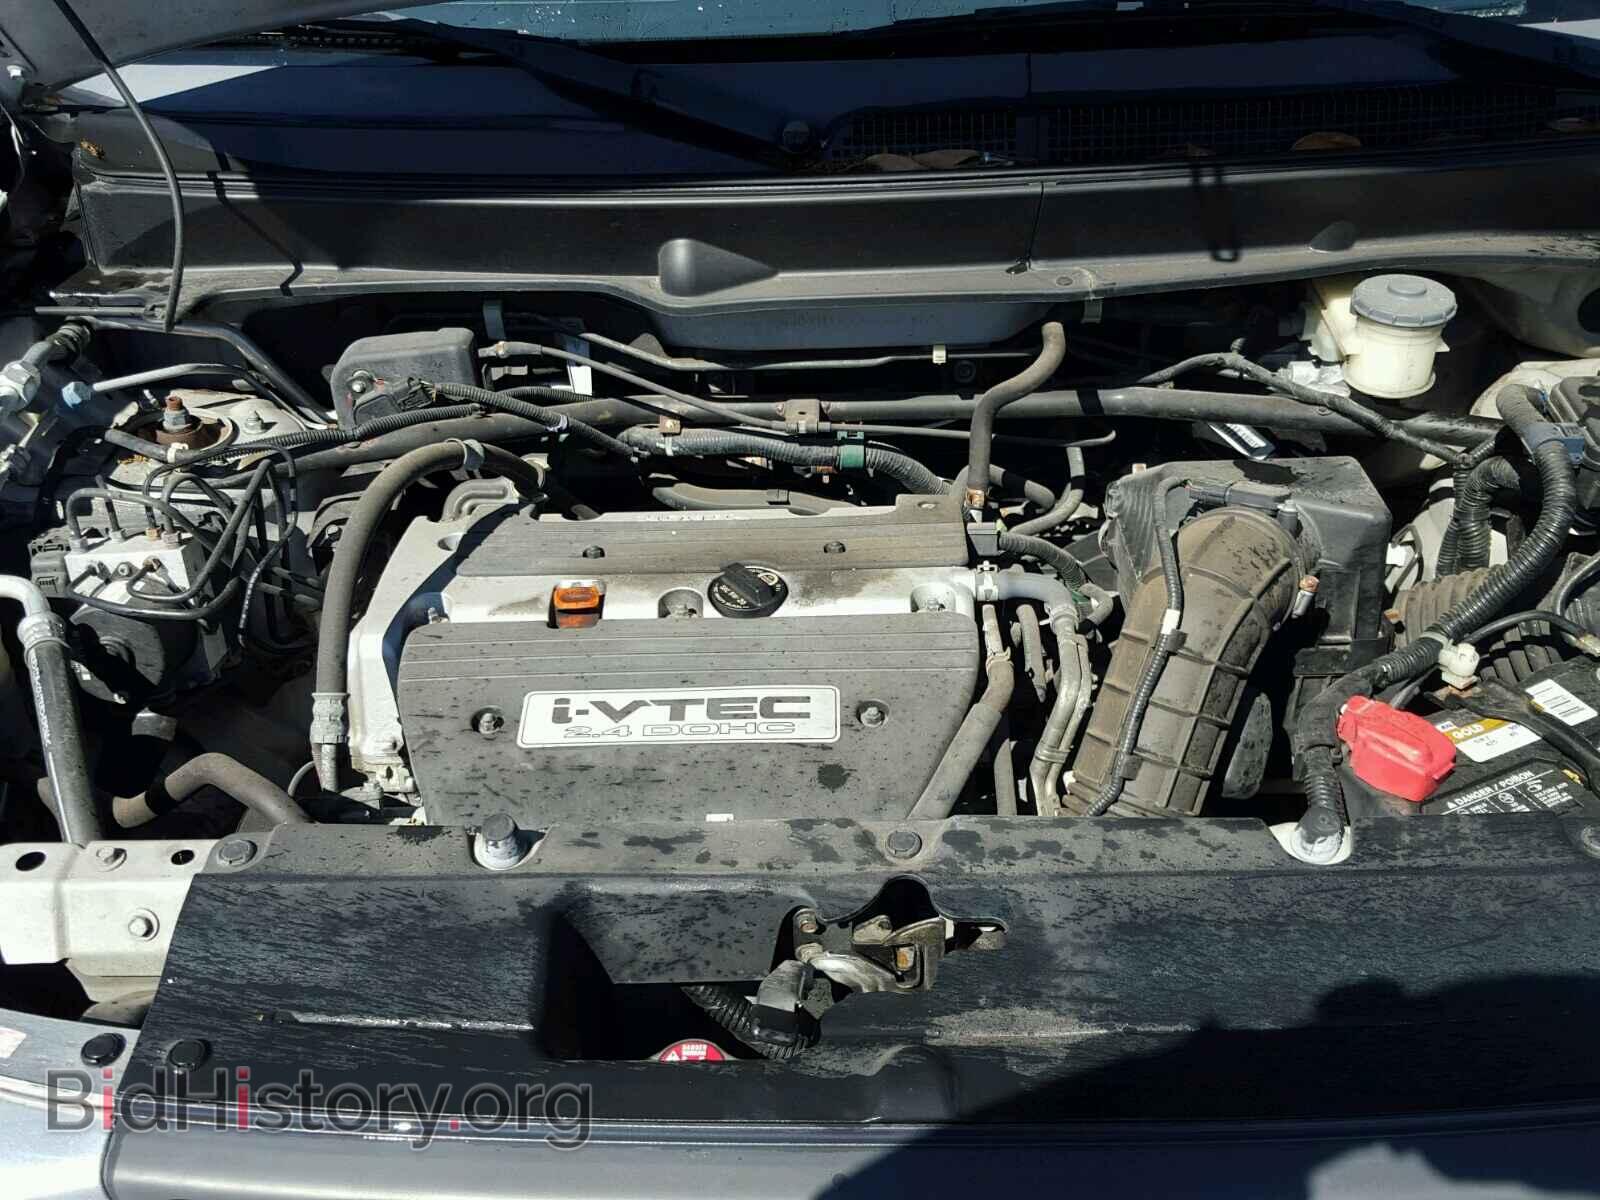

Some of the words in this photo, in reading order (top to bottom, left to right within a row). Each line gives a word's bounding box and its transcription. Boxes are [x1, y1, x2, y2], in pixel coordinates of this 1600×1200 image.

[551, 696, 811, 723] i-VTEC
[563, 724, 633, 738] 2.4
[642, 721, 797, 737] DOHC
[1454, 786, 1495, 805] DANGER
[1498, 770, 1534, 787] POISON
